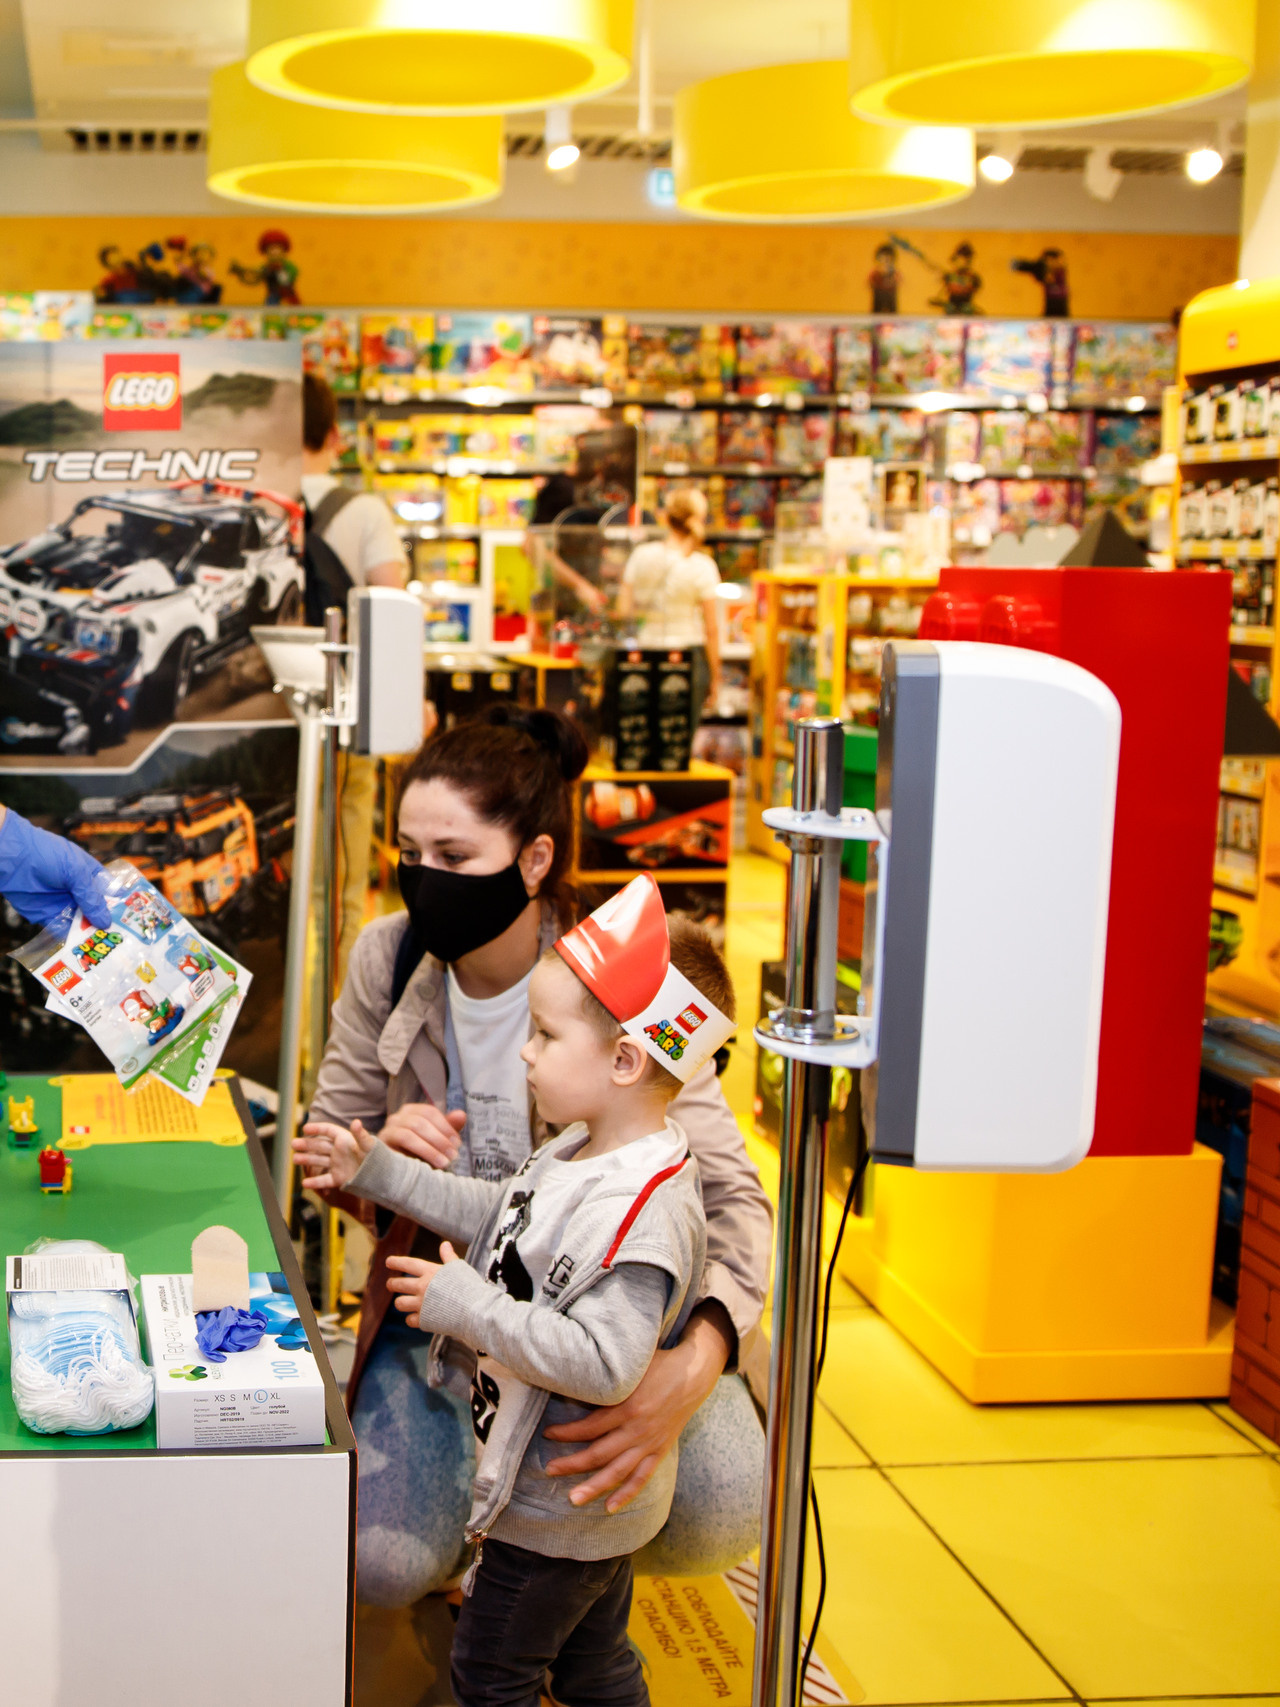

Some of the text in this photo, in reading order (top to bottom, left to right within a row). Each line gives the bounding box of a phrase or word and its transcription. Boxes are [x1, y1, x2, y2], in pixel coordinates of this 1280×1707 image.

[107, 375, 177, 408] LEGO
[24, 449, 260, 482] TECHNIC
[72, 929, 108, 957] SUPER
[78, 931, 123, 973] MARIO
[51, 968, 73, 987] LEGO
[69, 995, 83, 1008] 6+
[658, 1019, 689, 1049] SUPER
[681, 1010, 702, 1028] LEGO
[643, 1023, 684, 1060] MARIO
[163, 1318, 188, 1361] Перчатки
[270, 1361, 300, 1380] 100
[214, 1394, 226, 1402] XS
[243, 1393, 251, 1401] M
[270, 1392, 280, 1400] XL
[637, 1598, 683, 1659] СПАСИБО!
[681, 1586, 744, 1669] СОБЛЮДАЙТЕ
[696, 1657, 732, 1699] МЕТРА
